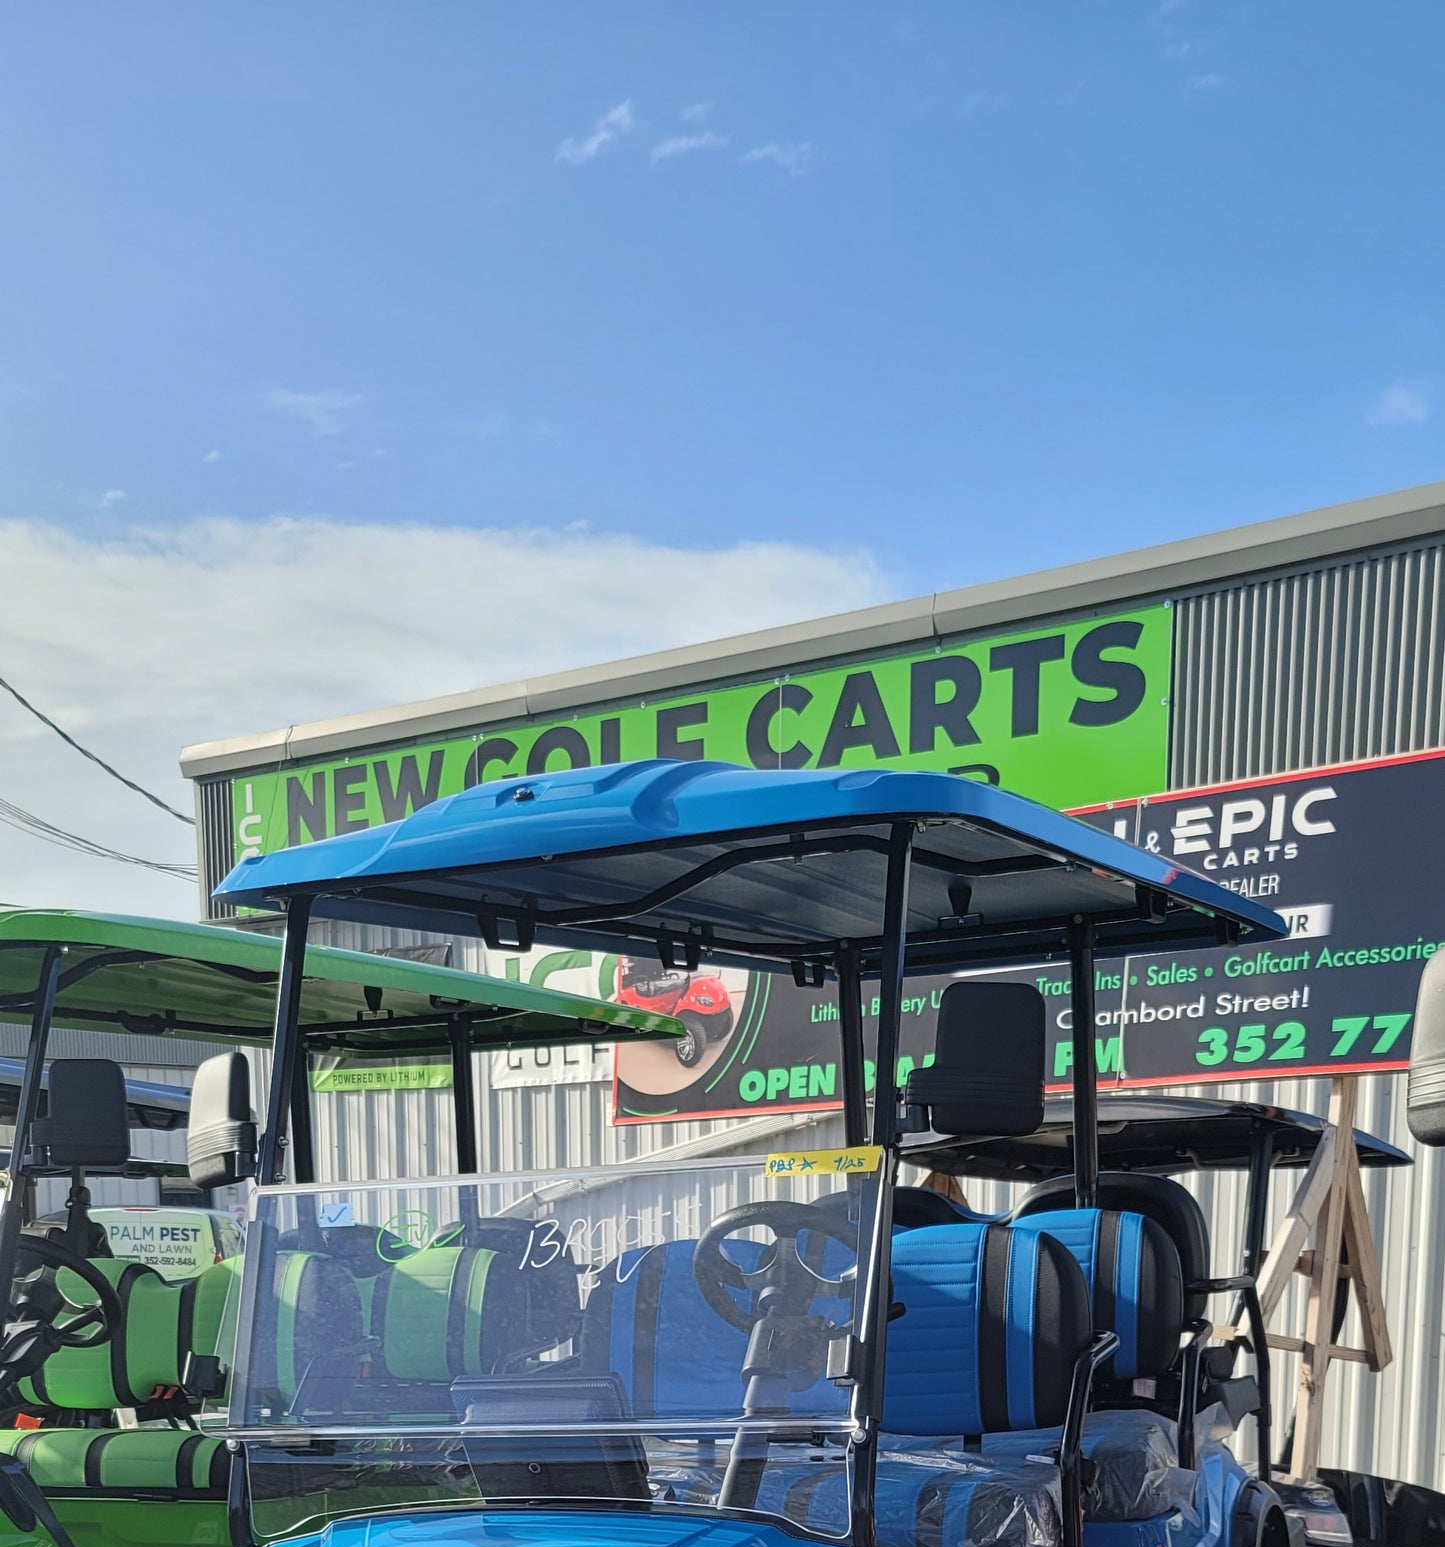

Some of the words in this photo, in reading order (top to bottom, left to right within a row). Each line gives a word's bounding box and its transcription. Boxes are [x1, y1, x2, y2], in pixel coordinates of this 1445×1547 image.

[286, 749, 445, 848] NEW
[746, 621, 1147, 769] CARTS
[1170, 786, 1338, 856] EPIC
[1203, 842, 1299, 871] CARTS
[1146, 961, 1197, 986] Sales
[1224, 949, 1310, 978] Golfcart
[1056, 991, 1204, 1029] Cambord
[1215, 985, 1310, 1016] Street!
[332, 1073, 373, 1085] POWERED
[376, 1073, 387, 1083] BY
[390, 1070, 425, 1082] LITHIUM
[739, 1063, 837, 1102] OPEN
[1195, 1022, 1306, 1066] 352
[110, 1226, 154, 1240] PALM
[160, 1227, 201, 1242] PEST
[131, 1244, 155, 1253] AND
[159, 1244, 192, 1254] LAWN
